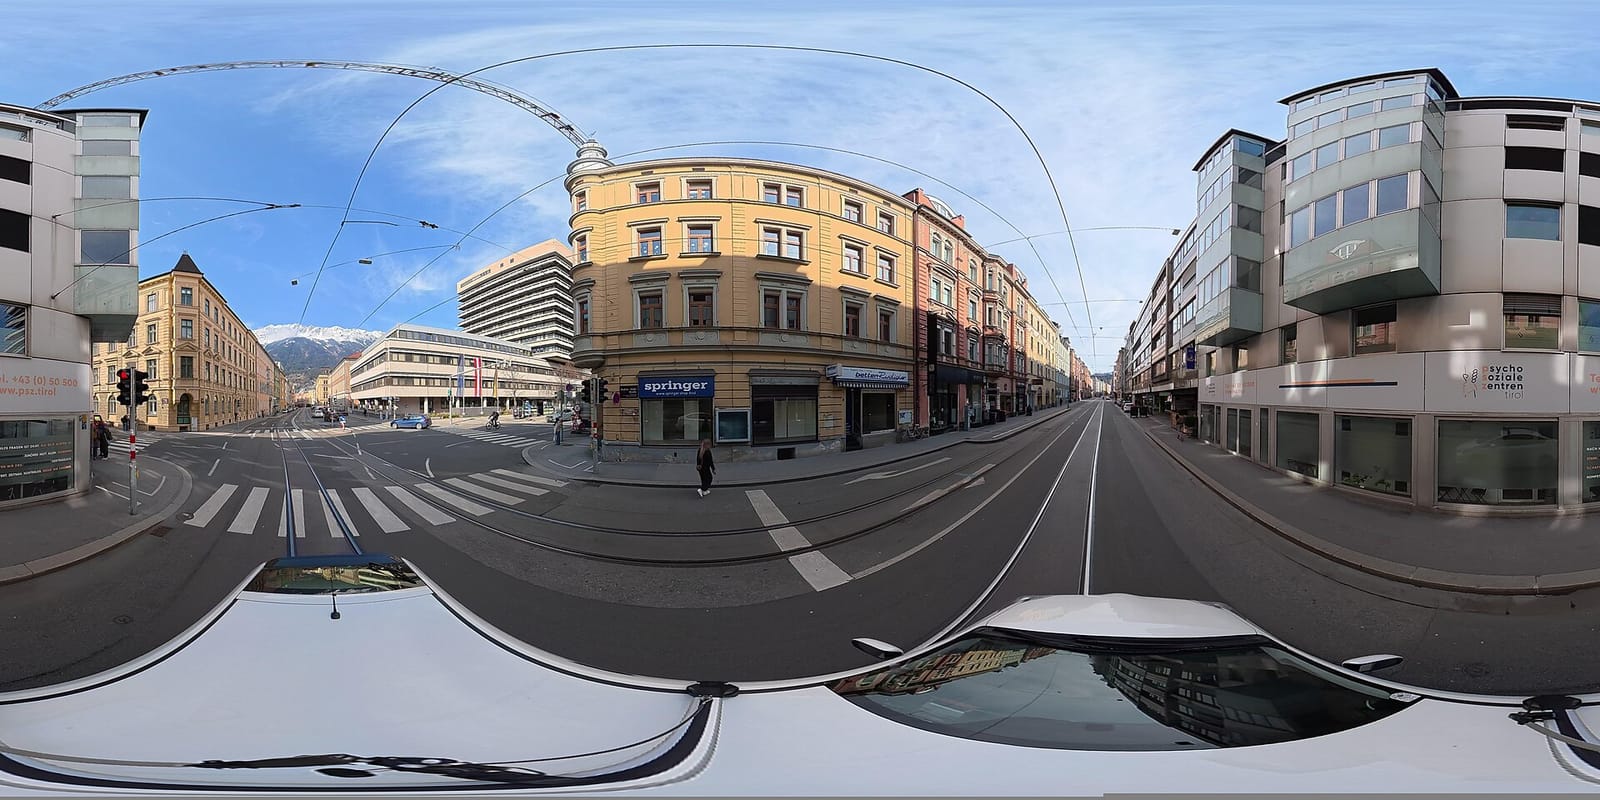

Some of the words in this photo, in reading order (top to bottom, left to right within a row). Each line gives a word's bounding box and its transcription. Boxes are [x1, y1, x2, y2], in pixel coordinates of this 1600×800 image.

[1482, 364, 1523, 374] psycho
[12, 375, 31, 385] +43
[33, 375, 46, 386] (0)
[49, 377, 60, 386] 50
[62, 378, 78, 387] 500
[1482, 373, 1523, 381] soziale
[644, 380, 708, 392] springer
[1482, 381, 1523, 390] zentren
[1505, 391, 1524, 399] tirol
